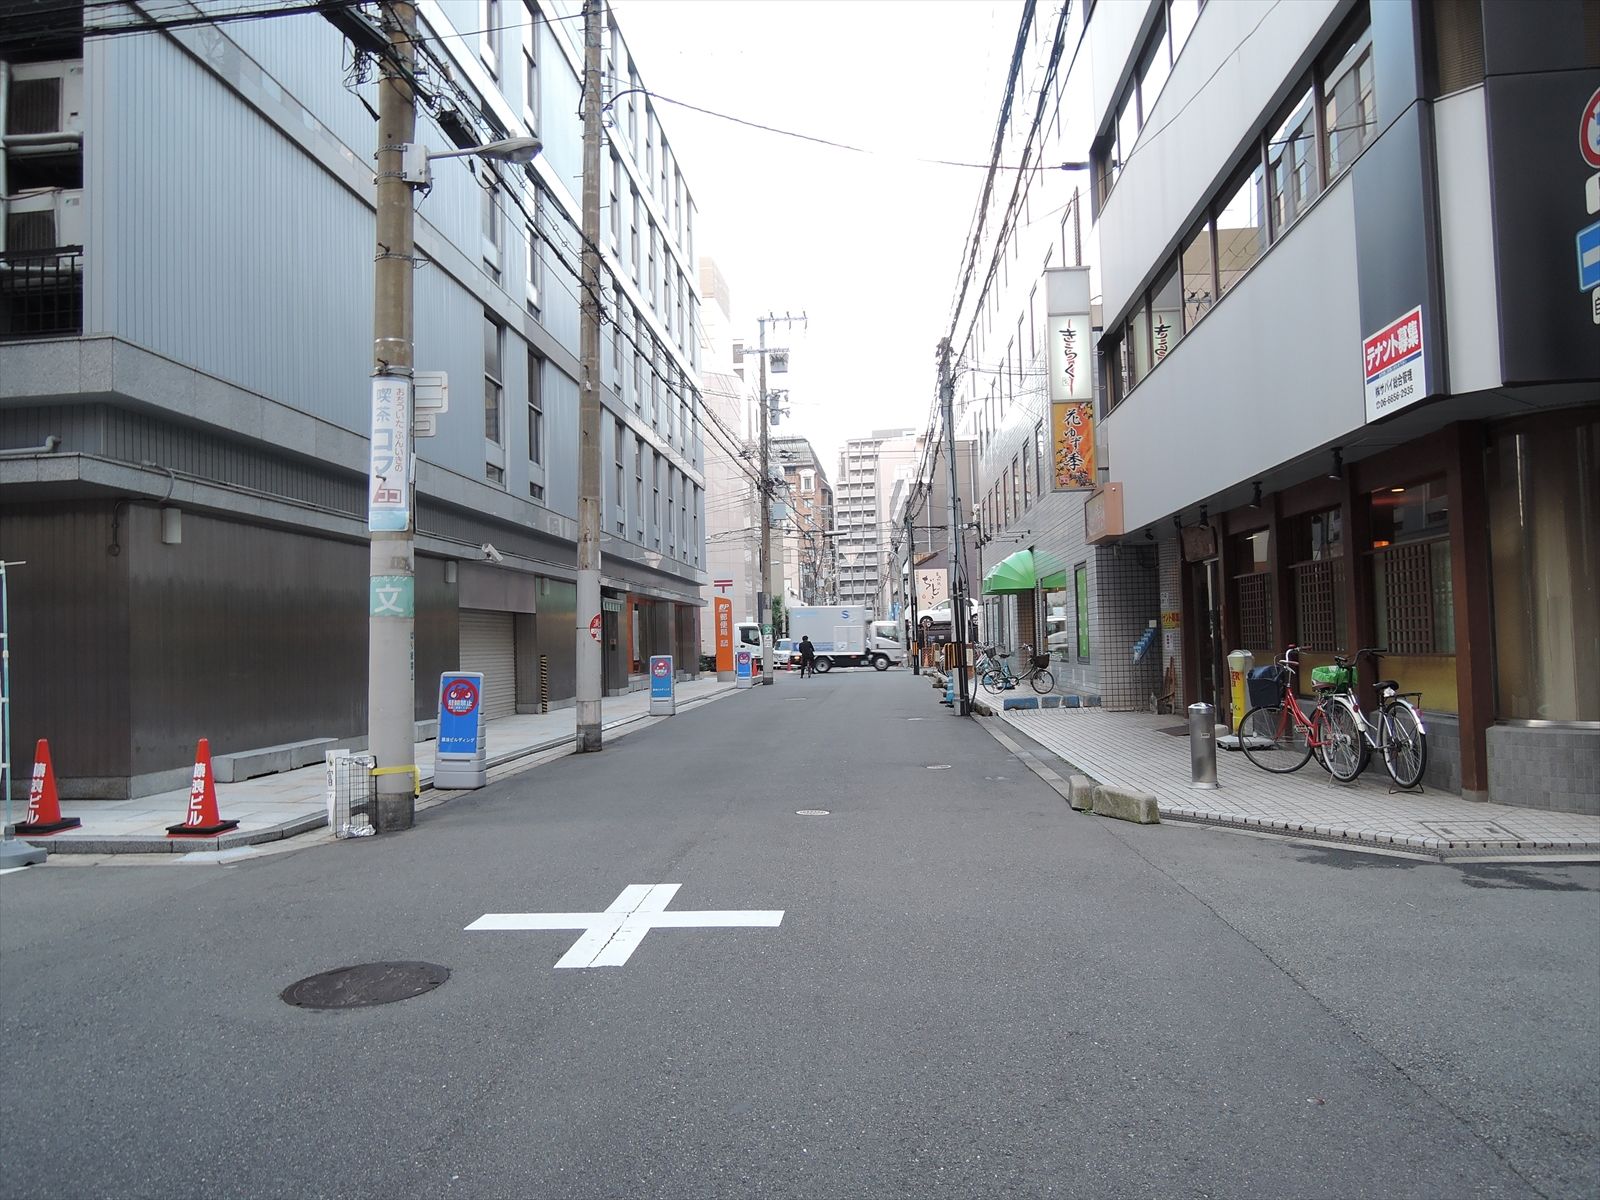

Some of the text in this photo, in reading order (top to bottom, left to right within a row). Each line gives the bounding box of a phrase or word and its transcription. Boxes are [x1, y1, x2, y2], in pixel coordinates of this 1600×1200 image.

[1366, 319, 1420, 372] テナント募集
[374, 583, 405, 613] 文
